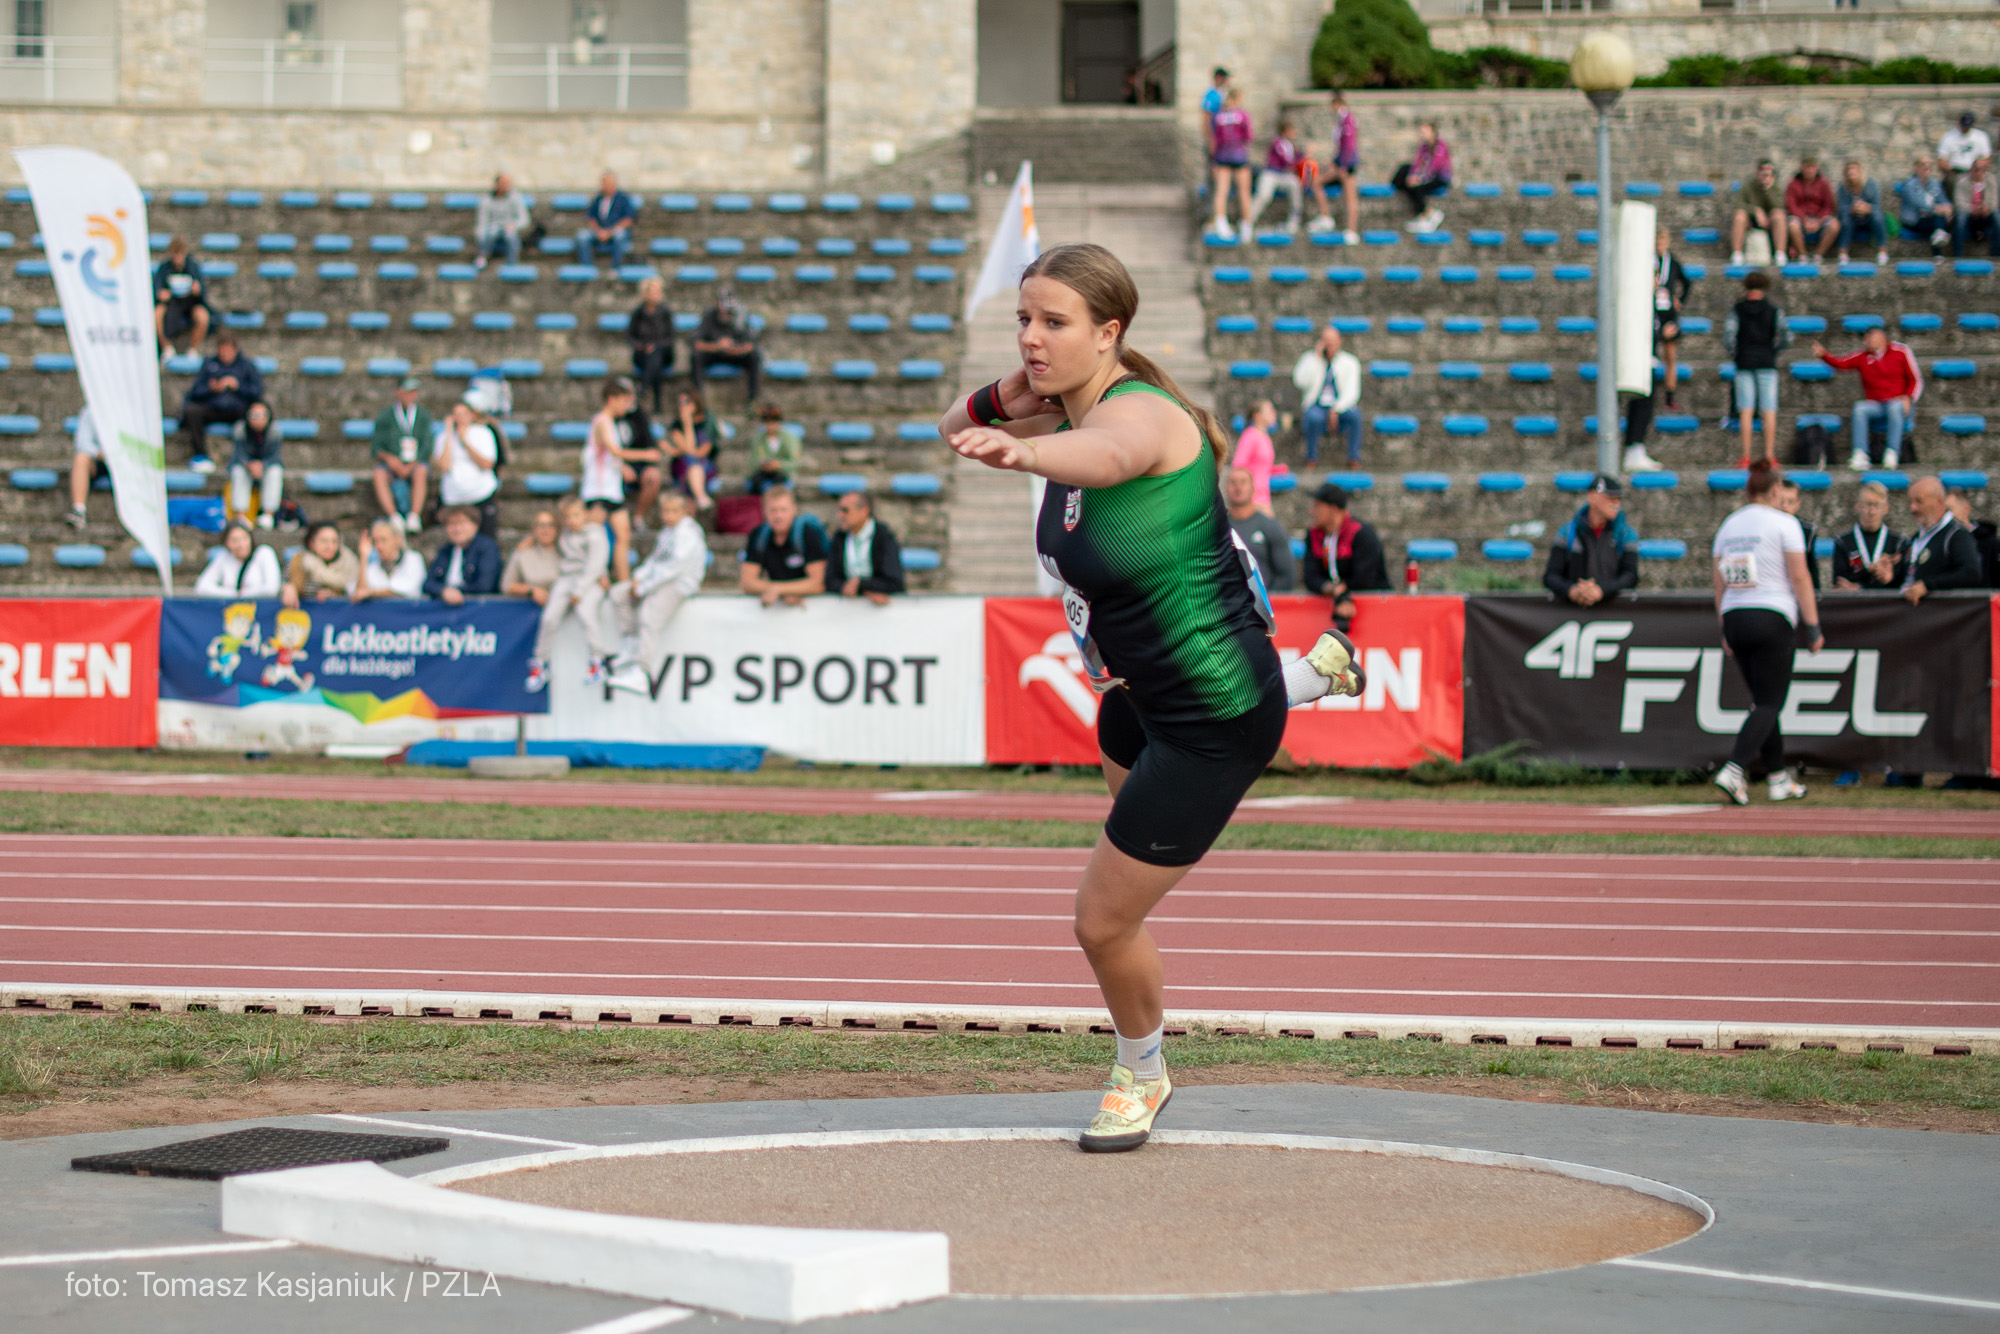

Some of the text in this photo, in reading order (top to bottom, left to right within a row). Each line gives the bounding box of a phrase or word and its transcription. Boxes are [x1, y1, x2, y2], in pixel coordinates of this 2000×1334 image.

[322, 623, 498, 661] Lekkoatletyka
[1524, 620, 1634, 679] 4F
[322, 655, 416, 679] dla każdego!
[732, 654, 938, 706] SPORT
[1620, 646, 1929, 737] FUEL
[1101, 1093, 1136, 1115] NIKE
